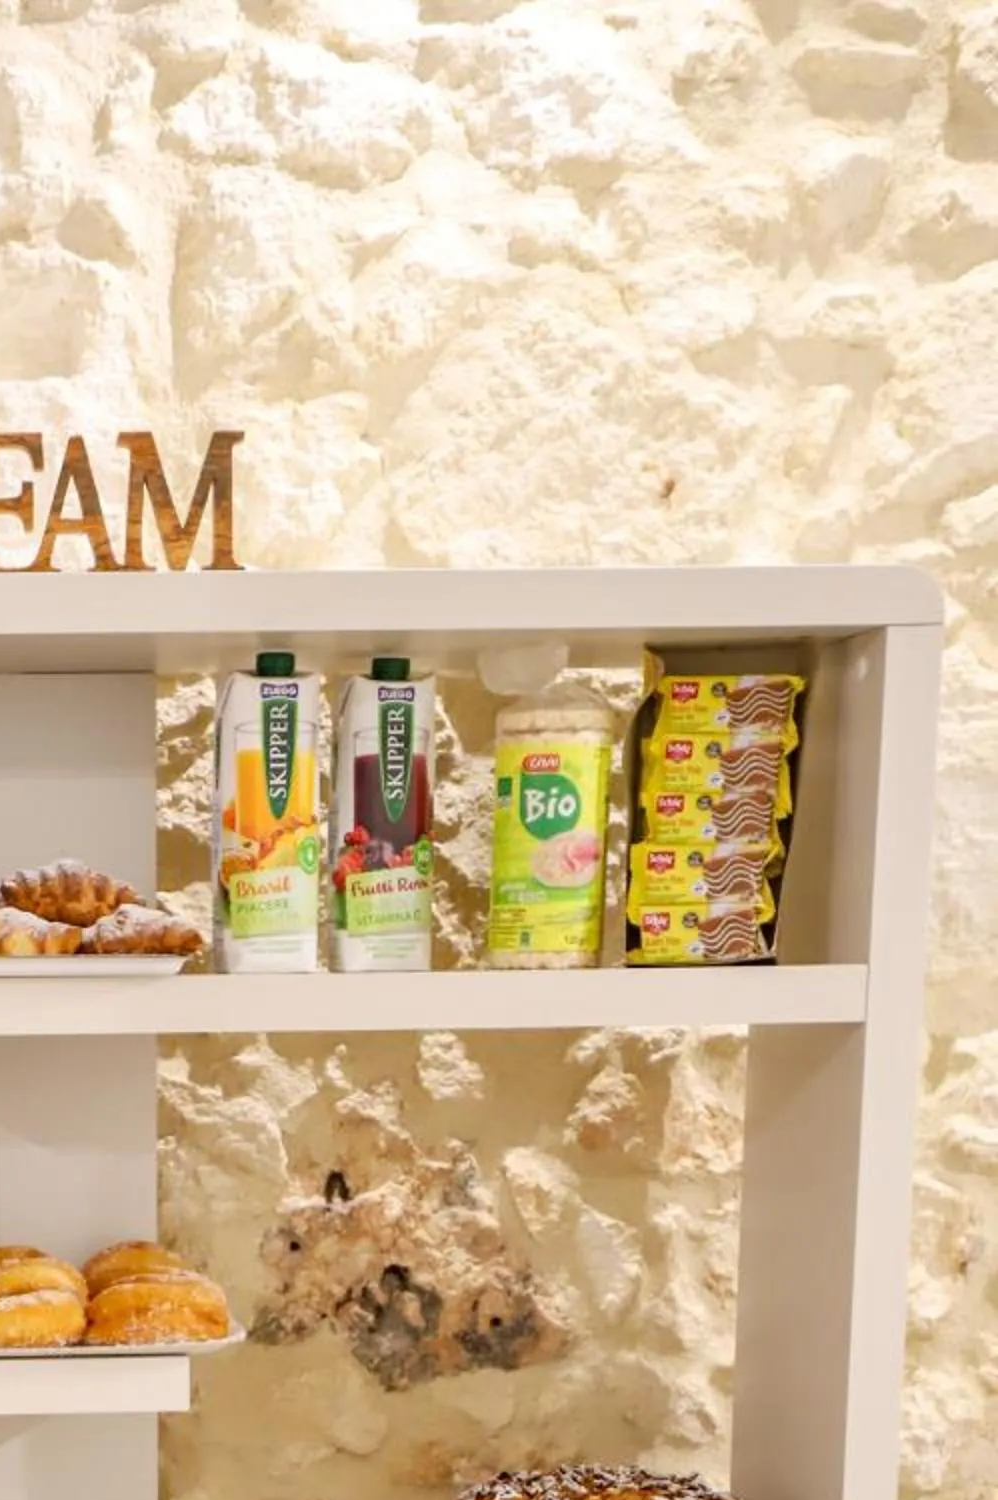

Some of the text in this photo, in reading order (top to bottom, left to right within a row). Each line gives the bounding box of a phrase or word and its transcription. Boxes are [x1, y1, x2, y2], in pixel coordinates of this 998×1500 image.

[269, 703, 288, 799] SKIPPER
[386, 707, 405, 800] SKIPPER
[524, 787, 576, 823] Bio
